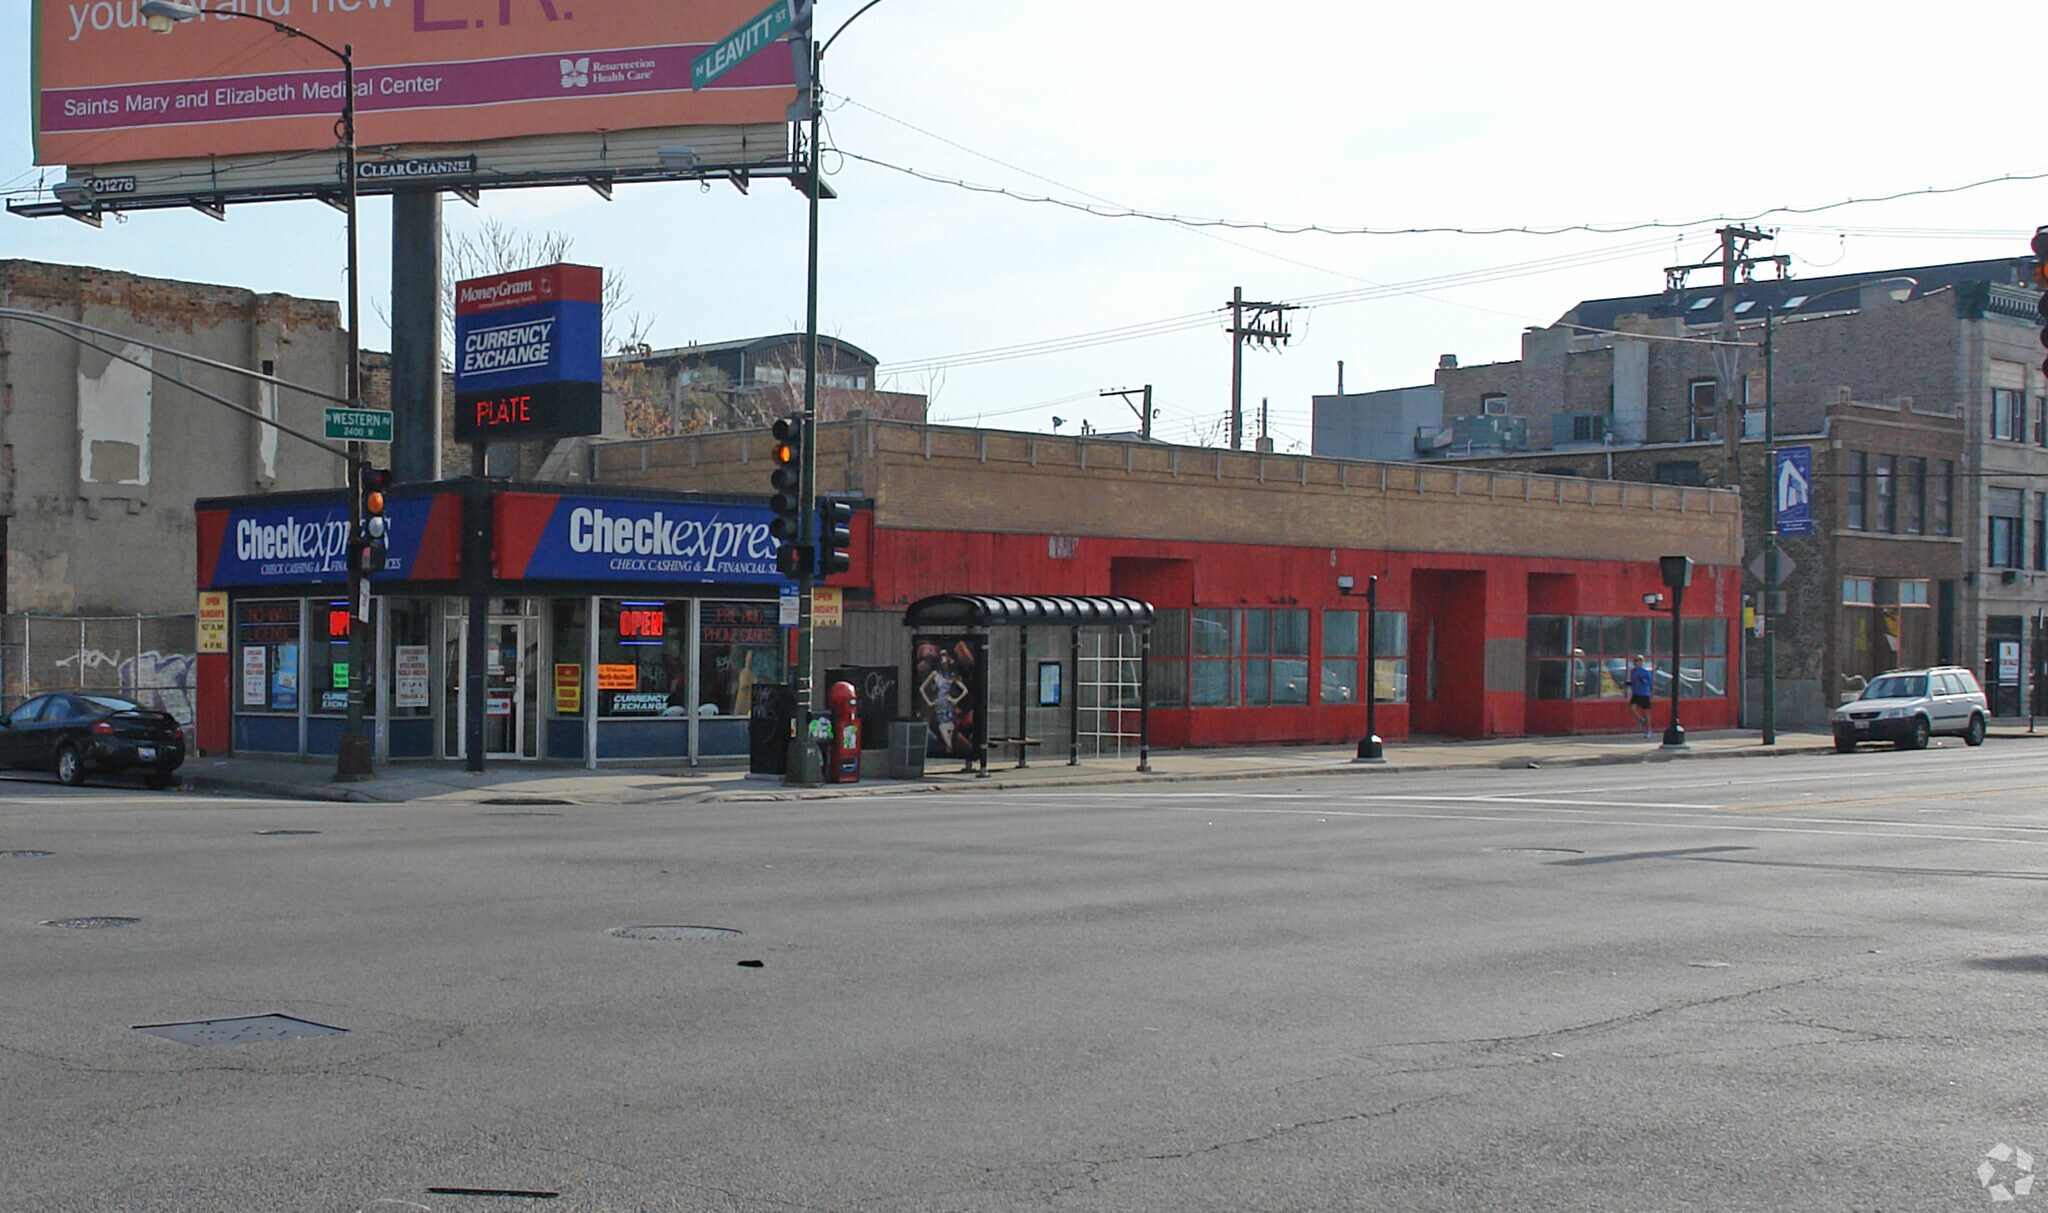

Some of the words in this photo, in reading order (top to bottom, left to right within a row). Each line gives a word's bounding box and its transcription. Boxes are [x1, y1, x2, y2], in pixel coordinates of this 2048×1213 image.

[696, 63, 704, 77] N
[706, 14, 772, 78] LEAVITT
[776, 9, 786, 23] ST
[593, 59, 656, 72] Resurrection
[593, 71, 625, 83] Health
[627, 70, 652, 81] Care
[64, 99, 119, 117] Saints
[125, 94, 170, 114] Mary
[175, 89, 208, 109] and
[215, 84, 295, 107] Elizabeth
[302, 78, 373, 100] Medical
[380, 76, 442, 95] Center
[460, 281, 533, 303] MoneyGram
[465, 323, 552, 353] CURRENCY
[463, 342, 551, 371] EXCHANGE
[332, 411, 380, 426] WESTERN
[477, 396, 531, 427] PLATE
[610, 558, 645, 572] CHECK
[647, 559, 692, 573] CASHING
[693, 562, 701, 573] &
[717, 562, 767, 575] FINANCIAL
[620, 611, 664, 636] OPEN
[613, 694, 669, 703] CURRENCY
[613, 702, 669, 711] EXCHANGE
